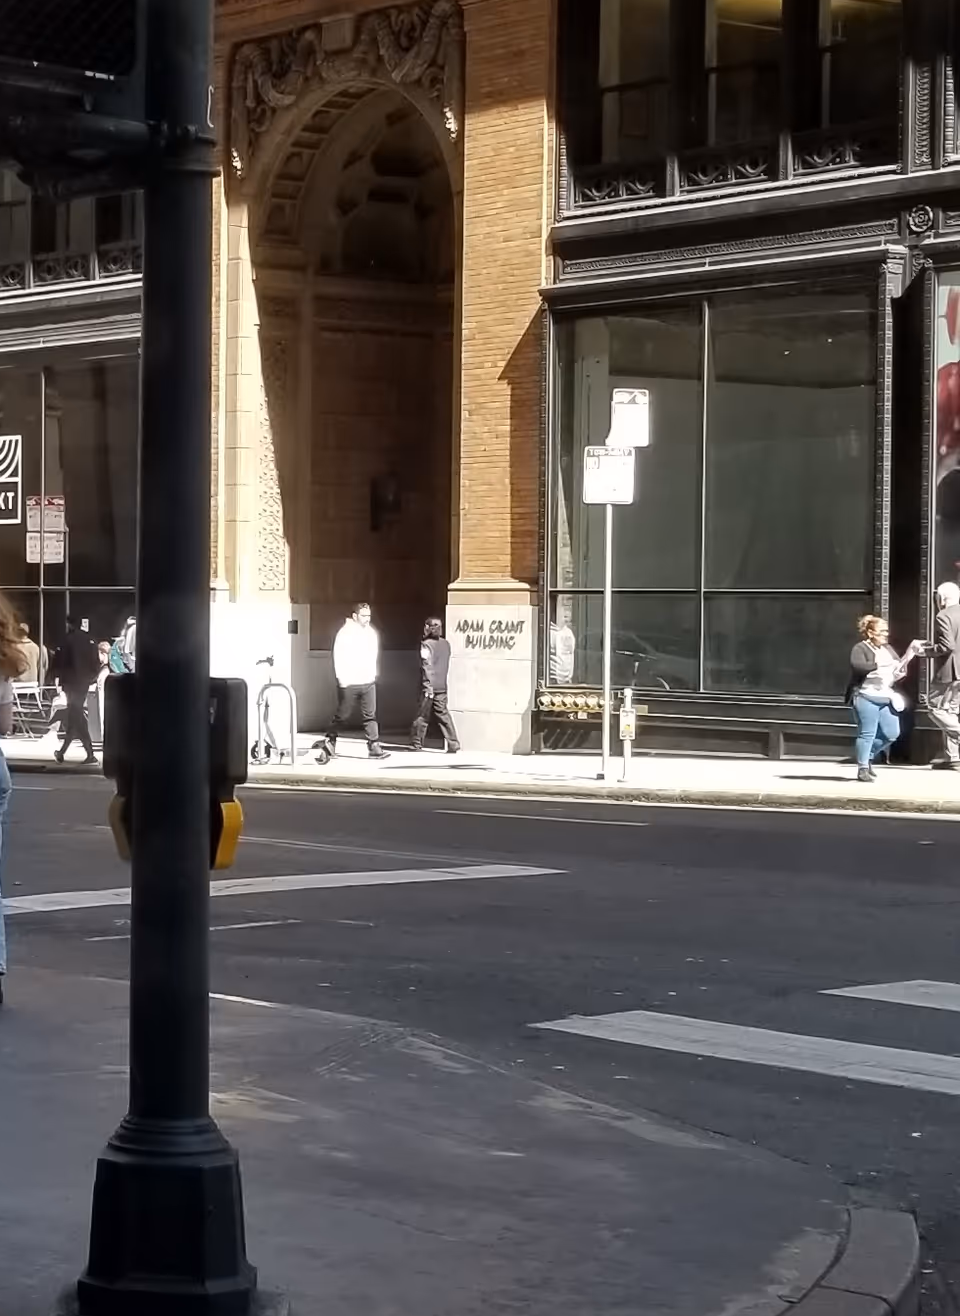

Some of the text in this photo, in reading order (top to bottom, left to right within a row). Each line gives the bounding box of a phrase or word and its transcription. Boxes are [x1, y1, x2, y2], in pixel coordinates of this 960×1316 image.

[455, 619, 526, 635] ADAM GRANT
[465, 634, 516, 651] BUILDING
